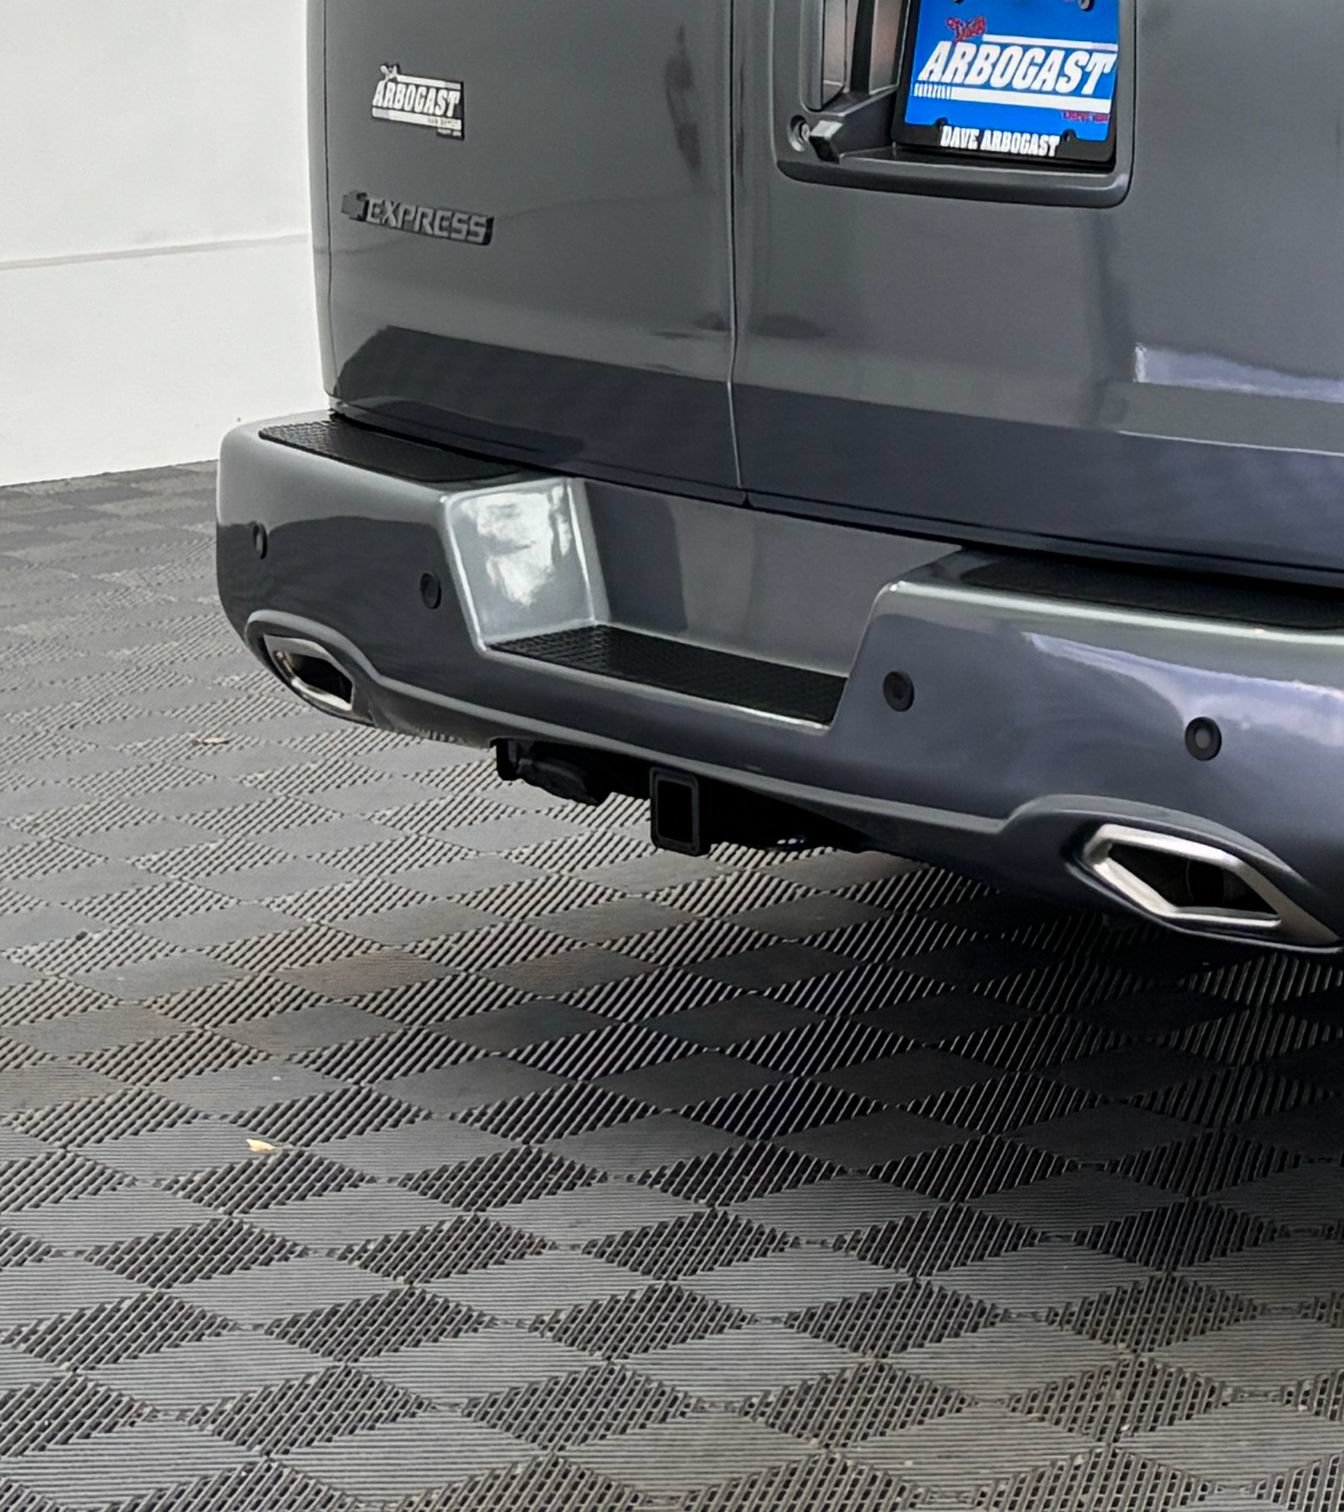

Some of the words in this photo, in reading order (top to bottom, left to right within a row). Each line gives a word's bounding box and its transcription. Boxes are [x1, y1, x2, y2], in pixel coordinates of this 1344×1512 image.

[917, 40, 1118, 95] ARBOGAST
[372, 79, 462, 118] ARBOGAST
[940, 125, 979, 151] DAVE
[980, 128, 1061, 158] ARBOGAST
[366, 198, 487, 244] EXPRESS
